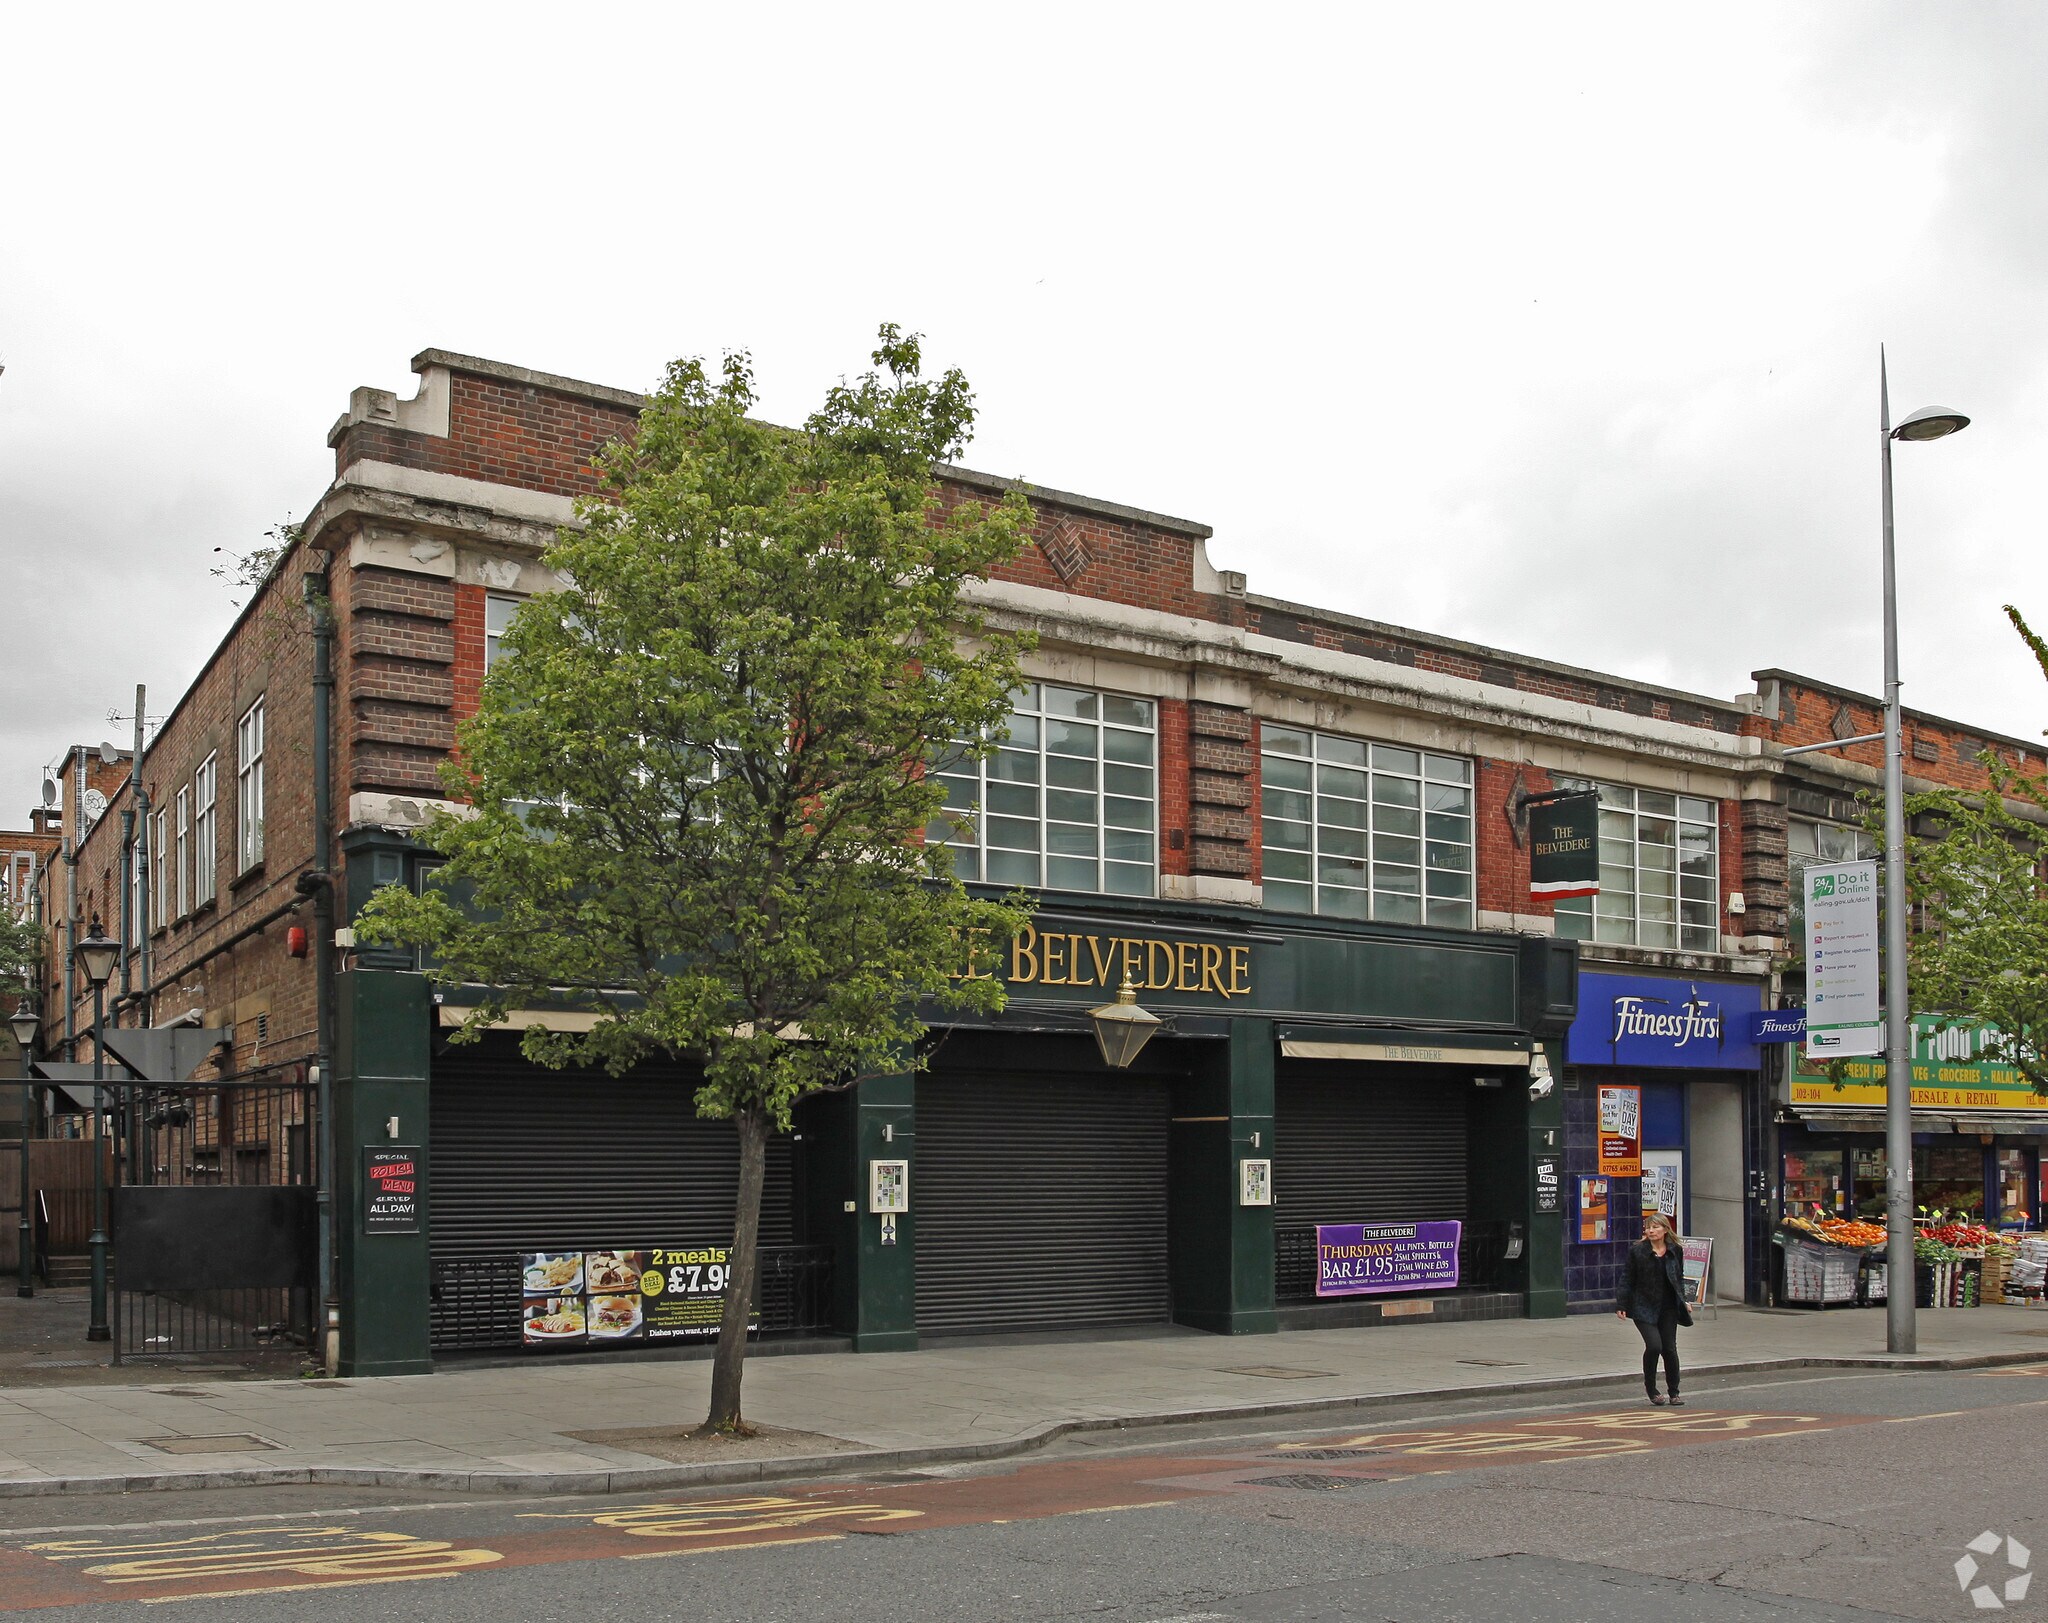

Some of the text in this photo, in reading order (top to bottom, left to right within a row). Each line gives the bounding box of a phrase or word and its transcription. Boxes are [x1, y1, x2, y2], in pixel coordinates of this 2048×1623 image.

[1552, 826, 1573, 839] THE
[1535, 838, 1590, 856] BELVEDERE
[1838, 871, 1869, 884] Do it
[1838, 884, 1870, 894] Online
[1008, 923, 1252, 999] BELVEDERE
[1383, 1046, 1442, 1060] THE BELVEDERE
[1912, 1066, 1929, 1081] VEG
[1938, 1067, 1981, 1084] GROCERIES
[1990, 1070, 2014, 1084] HALAL
[1796, 1088, 1820, 1100] 102-104
[1910, 1090, 1948, 1104] LESALE
[1954, 1092, 1961, 1104] &
[1966, 1092, 1999, 1105] RETAIL
[1622, 1100, 1638, 1114] FREE
[1622, 1112, 1636, 1126] DAY
[1620, 1124, 1635, 1138] PASS
[372, 1163, 414, 1178] POLISH
[383, 1179, 414, 1193] MENU
[1662, 1178, 1675, 1192] FREE
[1660, 1190, 1674, 1204] DAY
[370, 1204, 415, 1214] ALL DAY!
[1660, 1202, 1672, 1214] PASS
[1366, 1228, 1414, 1238] THE BELVEDERE
[1321, 1243, 1393, 1259] THURSDAYS
[1394, 1244, 1406, 1252] ALL
[1428, 1240, 1454, 1249] BOTTLES
[652, 1248, 664, 1265] 2
[666, 1248, 726, 1264] meals
[1322, 1256, 1393, 1279] BAR £1.95
[1414, 1261, 1436, 1270] WINE
[1394, 1273, 1410, 1281] FROM
[1426, 1270, 1454, 1278] MIDNIGHT
[649, 1328, 672, 1337] Dishes
[672, 1329, 684, 1337] you
